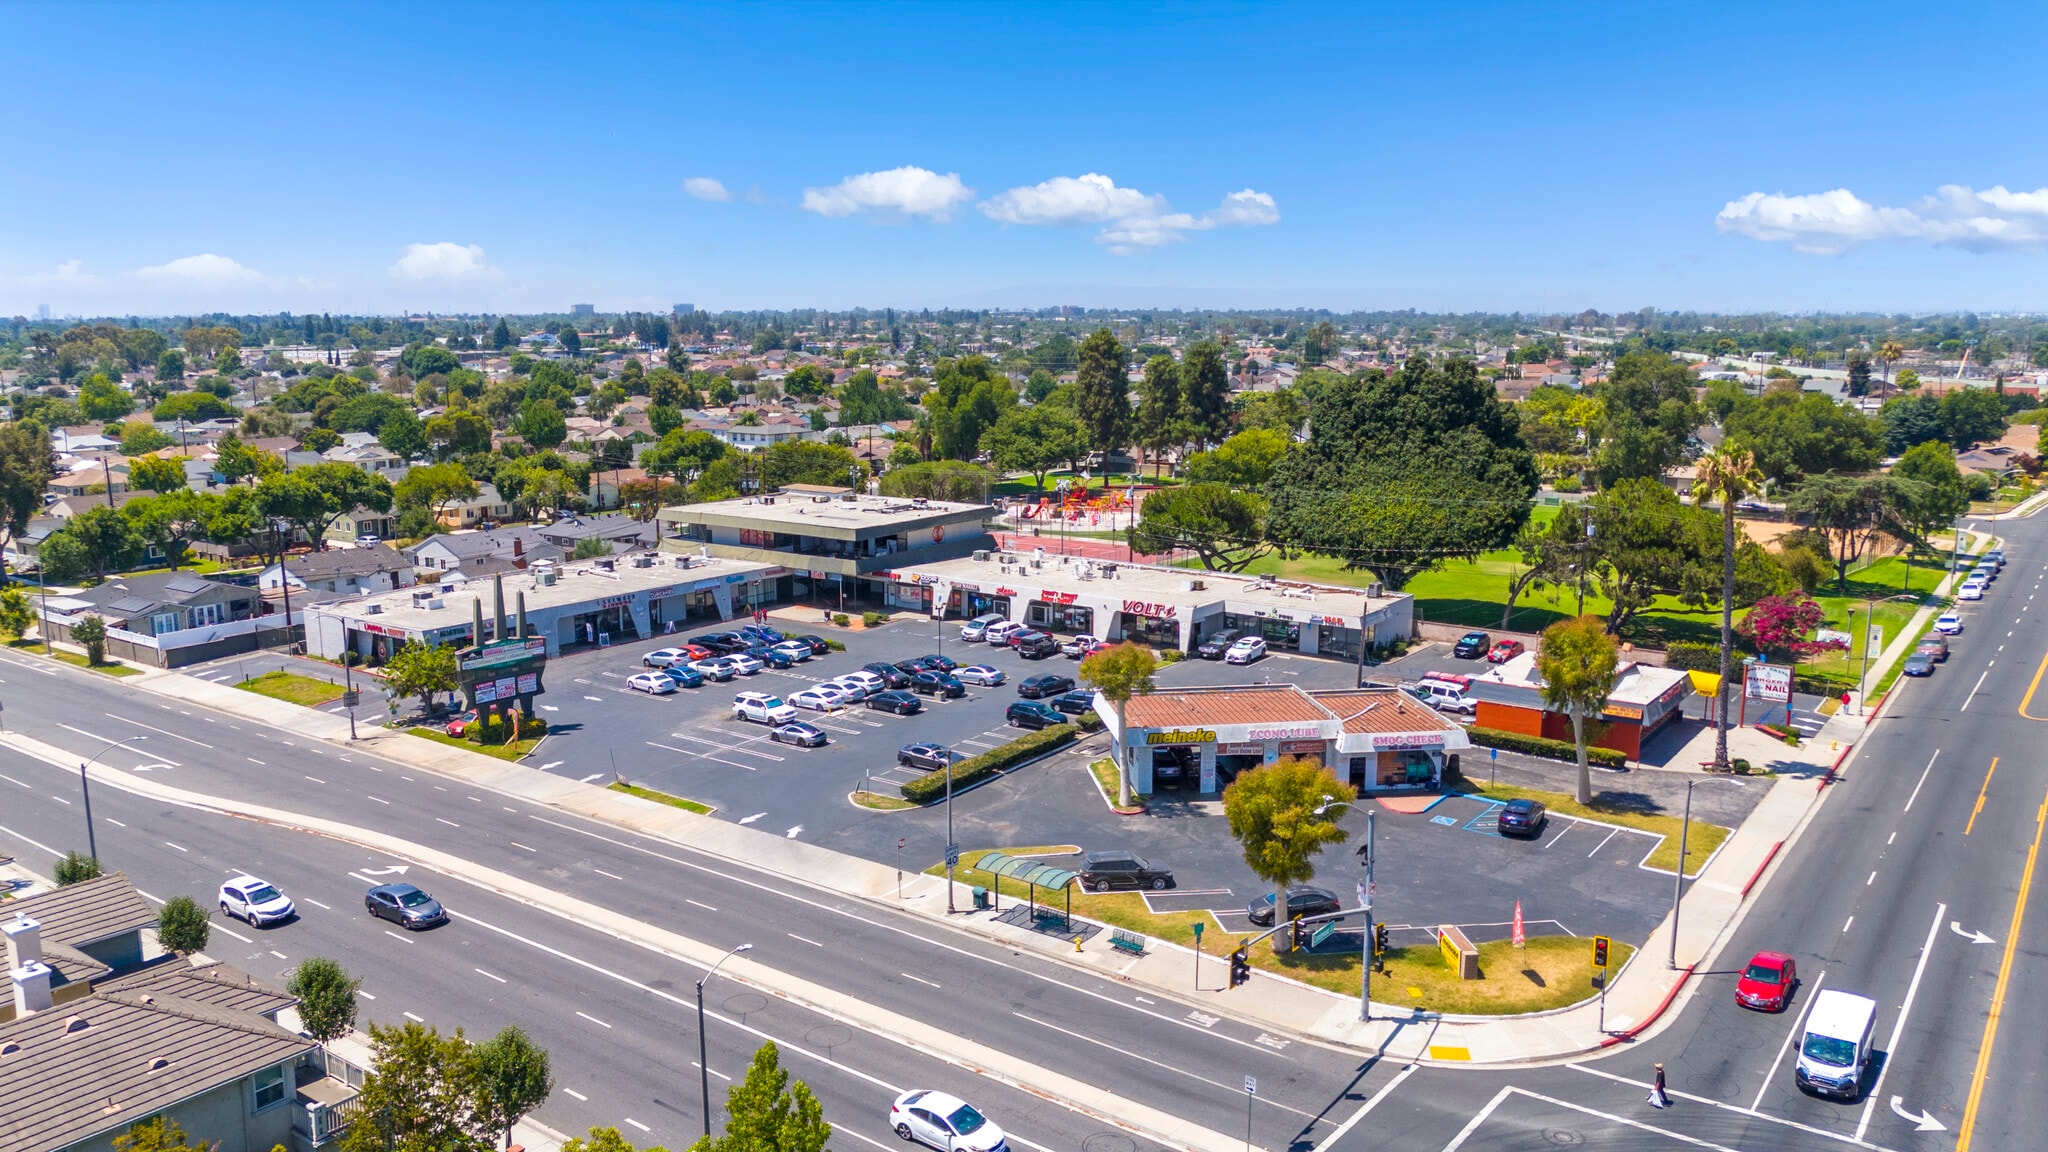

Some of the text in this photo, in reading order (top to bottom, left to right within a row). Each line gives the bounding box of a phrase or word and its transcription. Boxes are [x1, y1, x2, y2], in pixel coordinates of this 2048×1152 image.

[1765, 685, 1788, 694] NAIL
[1147, 728, 1216, 744] meineke
[1249, 728, 1320, 740] ECONO LUBE
[1373, 734, 1443, 746] SMOG CHECK
[948, 856, 958, 865] 40
